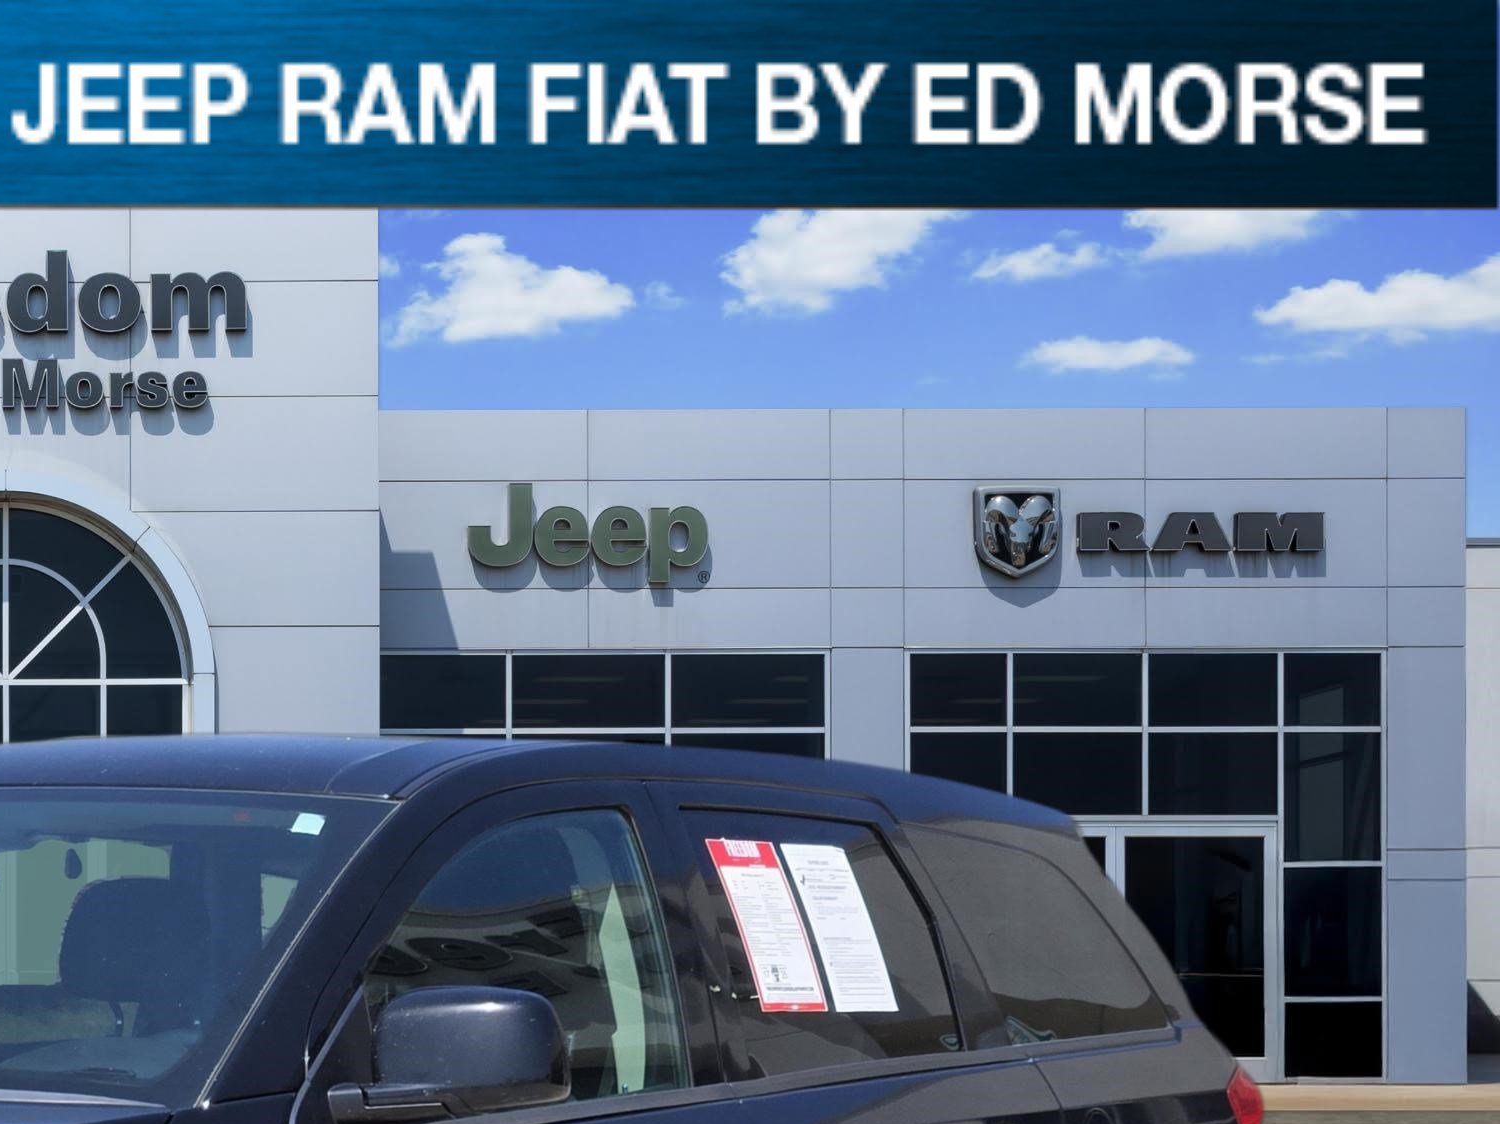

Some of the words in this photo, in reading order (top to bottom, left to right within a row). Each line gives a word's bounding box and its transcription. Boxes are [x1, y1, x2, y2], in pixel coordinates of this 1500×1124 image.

[2, 358, 209, 410] Morse
[467, 483, 709, 583] Jeep
[1076, 511, 1326, 553] RAM
